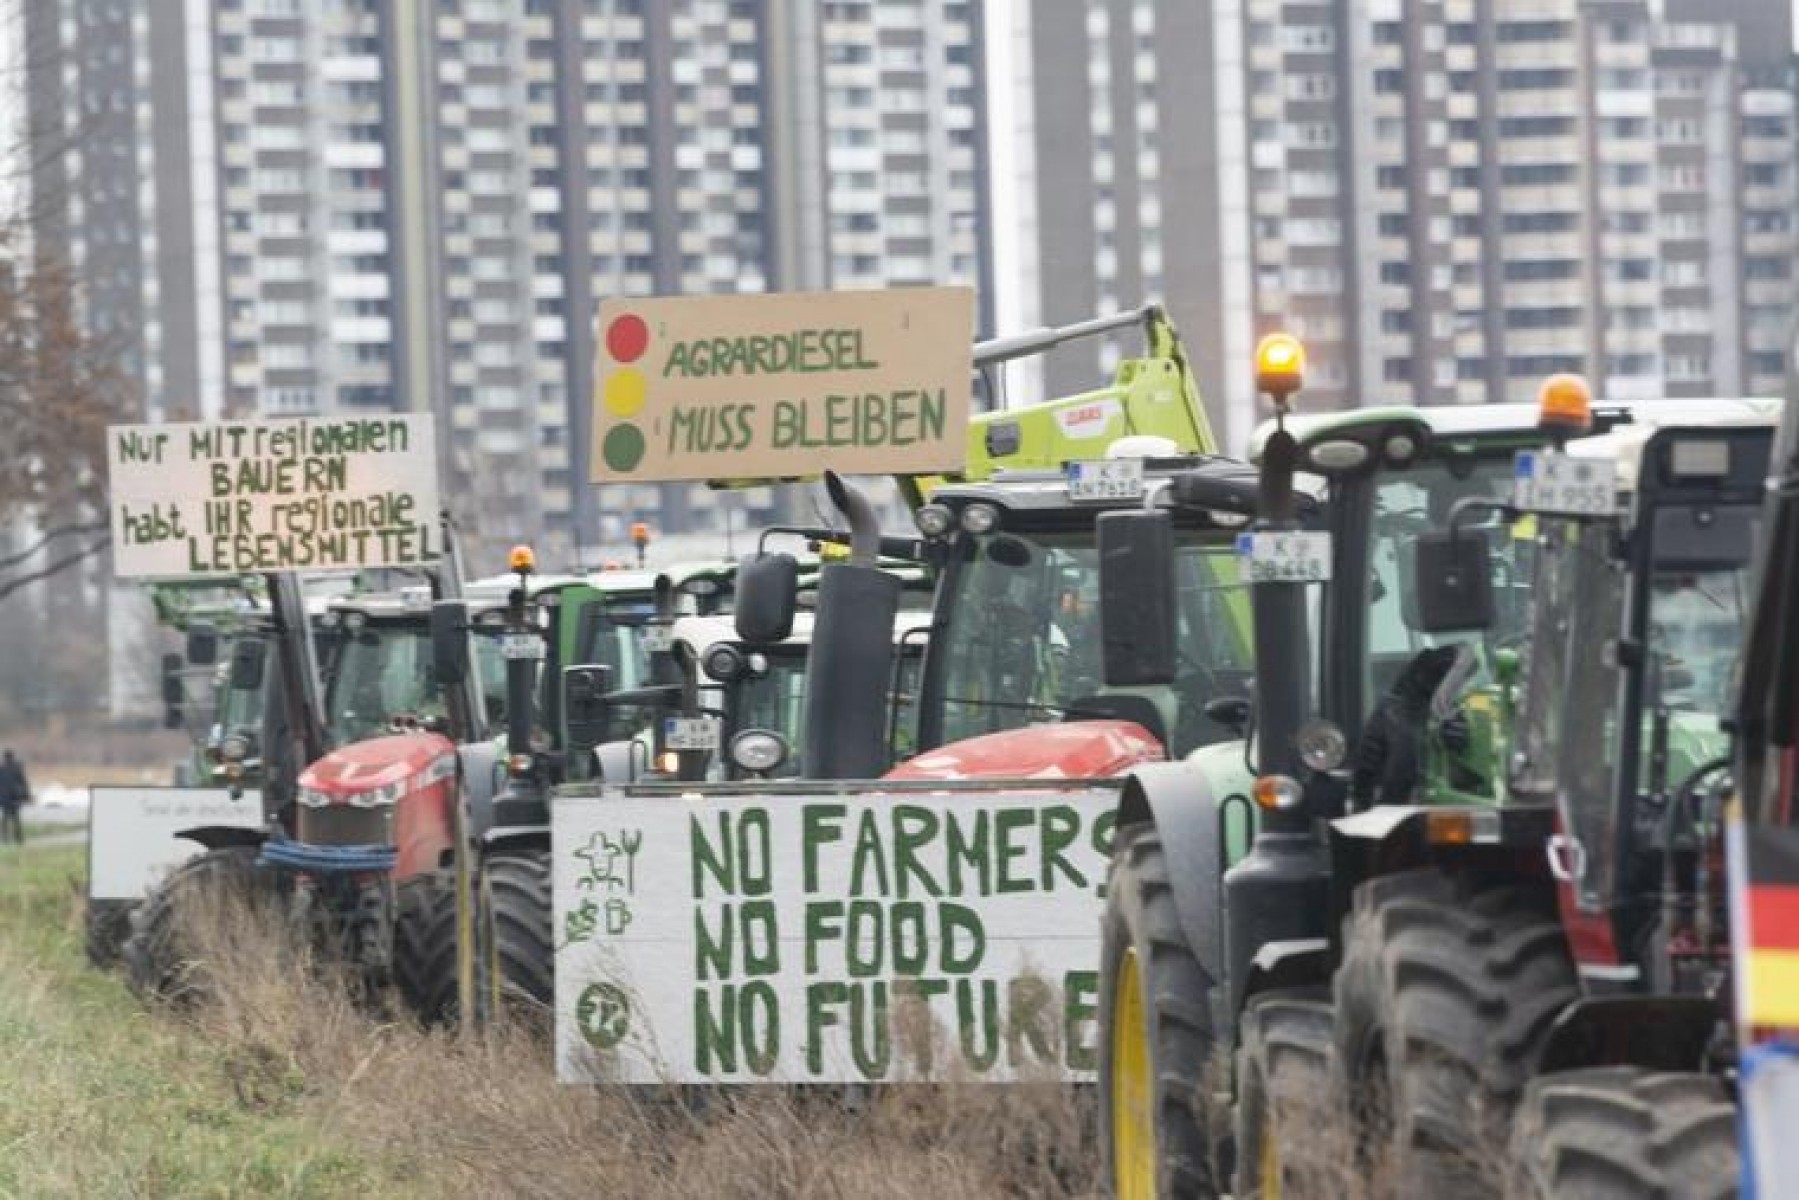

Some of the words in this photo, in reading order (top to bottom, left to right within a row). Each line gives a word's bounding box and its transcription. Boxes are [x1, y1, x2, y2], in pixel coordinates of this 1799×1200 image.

[663, 329, 879, 377] AGRARDIESEL
[191, 427, 246, 459] MIT
[254, 419, 408, 459] regionalen
[669, 404, 754, 455] MUSS
[772, 389, 945, 448] BLEIBEN
[212, 456, 346, 496] BAUERN
[205, 499, 252, 534] IHR
[271, 492, 414, 536] regionale
[188, 524, 443, 571] LEBENSMITTEL
[691, 807, 773, 899] NO
[695, 901, 780, 980] NO
[806, 901, 986, 977] FOOD
[694, 980, 780, 1076] NO
[806, 971, 1099, 1080] FUTURE
